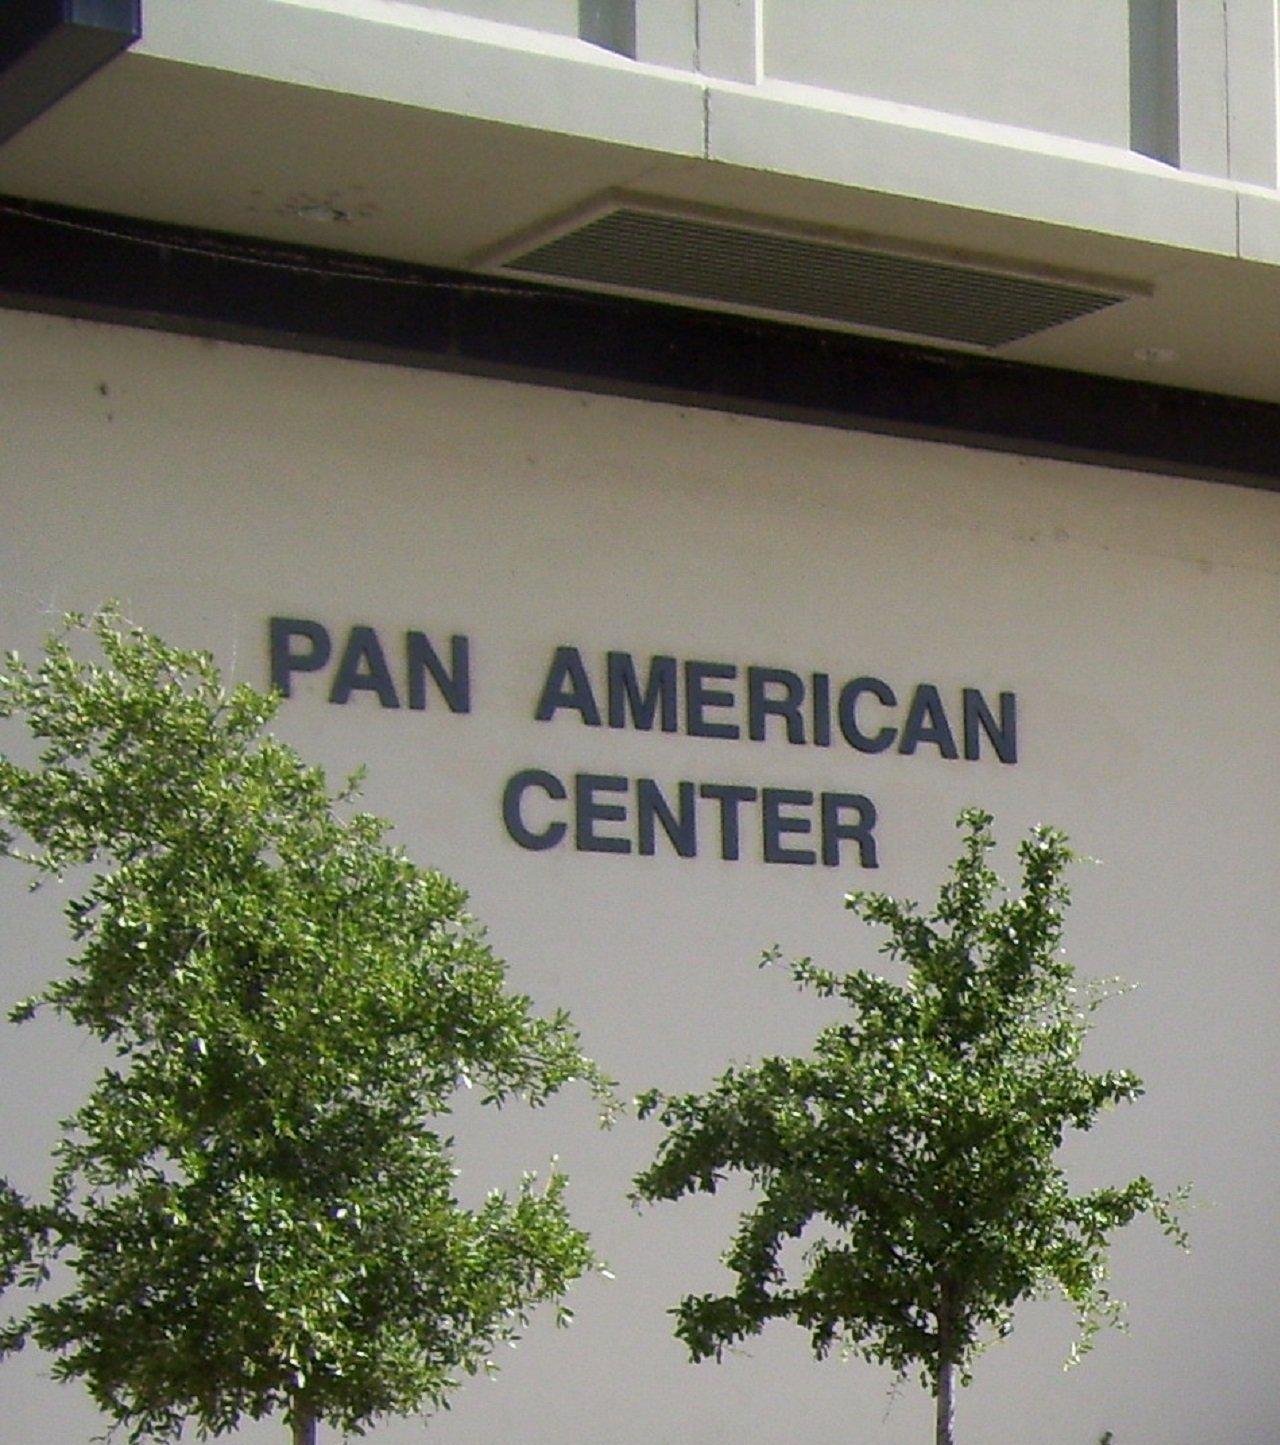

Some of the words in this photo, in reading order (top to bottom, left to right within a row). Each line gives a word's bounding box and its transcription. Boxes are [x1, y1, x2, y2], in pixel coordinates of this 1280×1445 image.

[269, 616, 472, 716] PAN
[535, 645, 1018, 765] AMERICAN
[501, 768, 879, 869] CENTER
